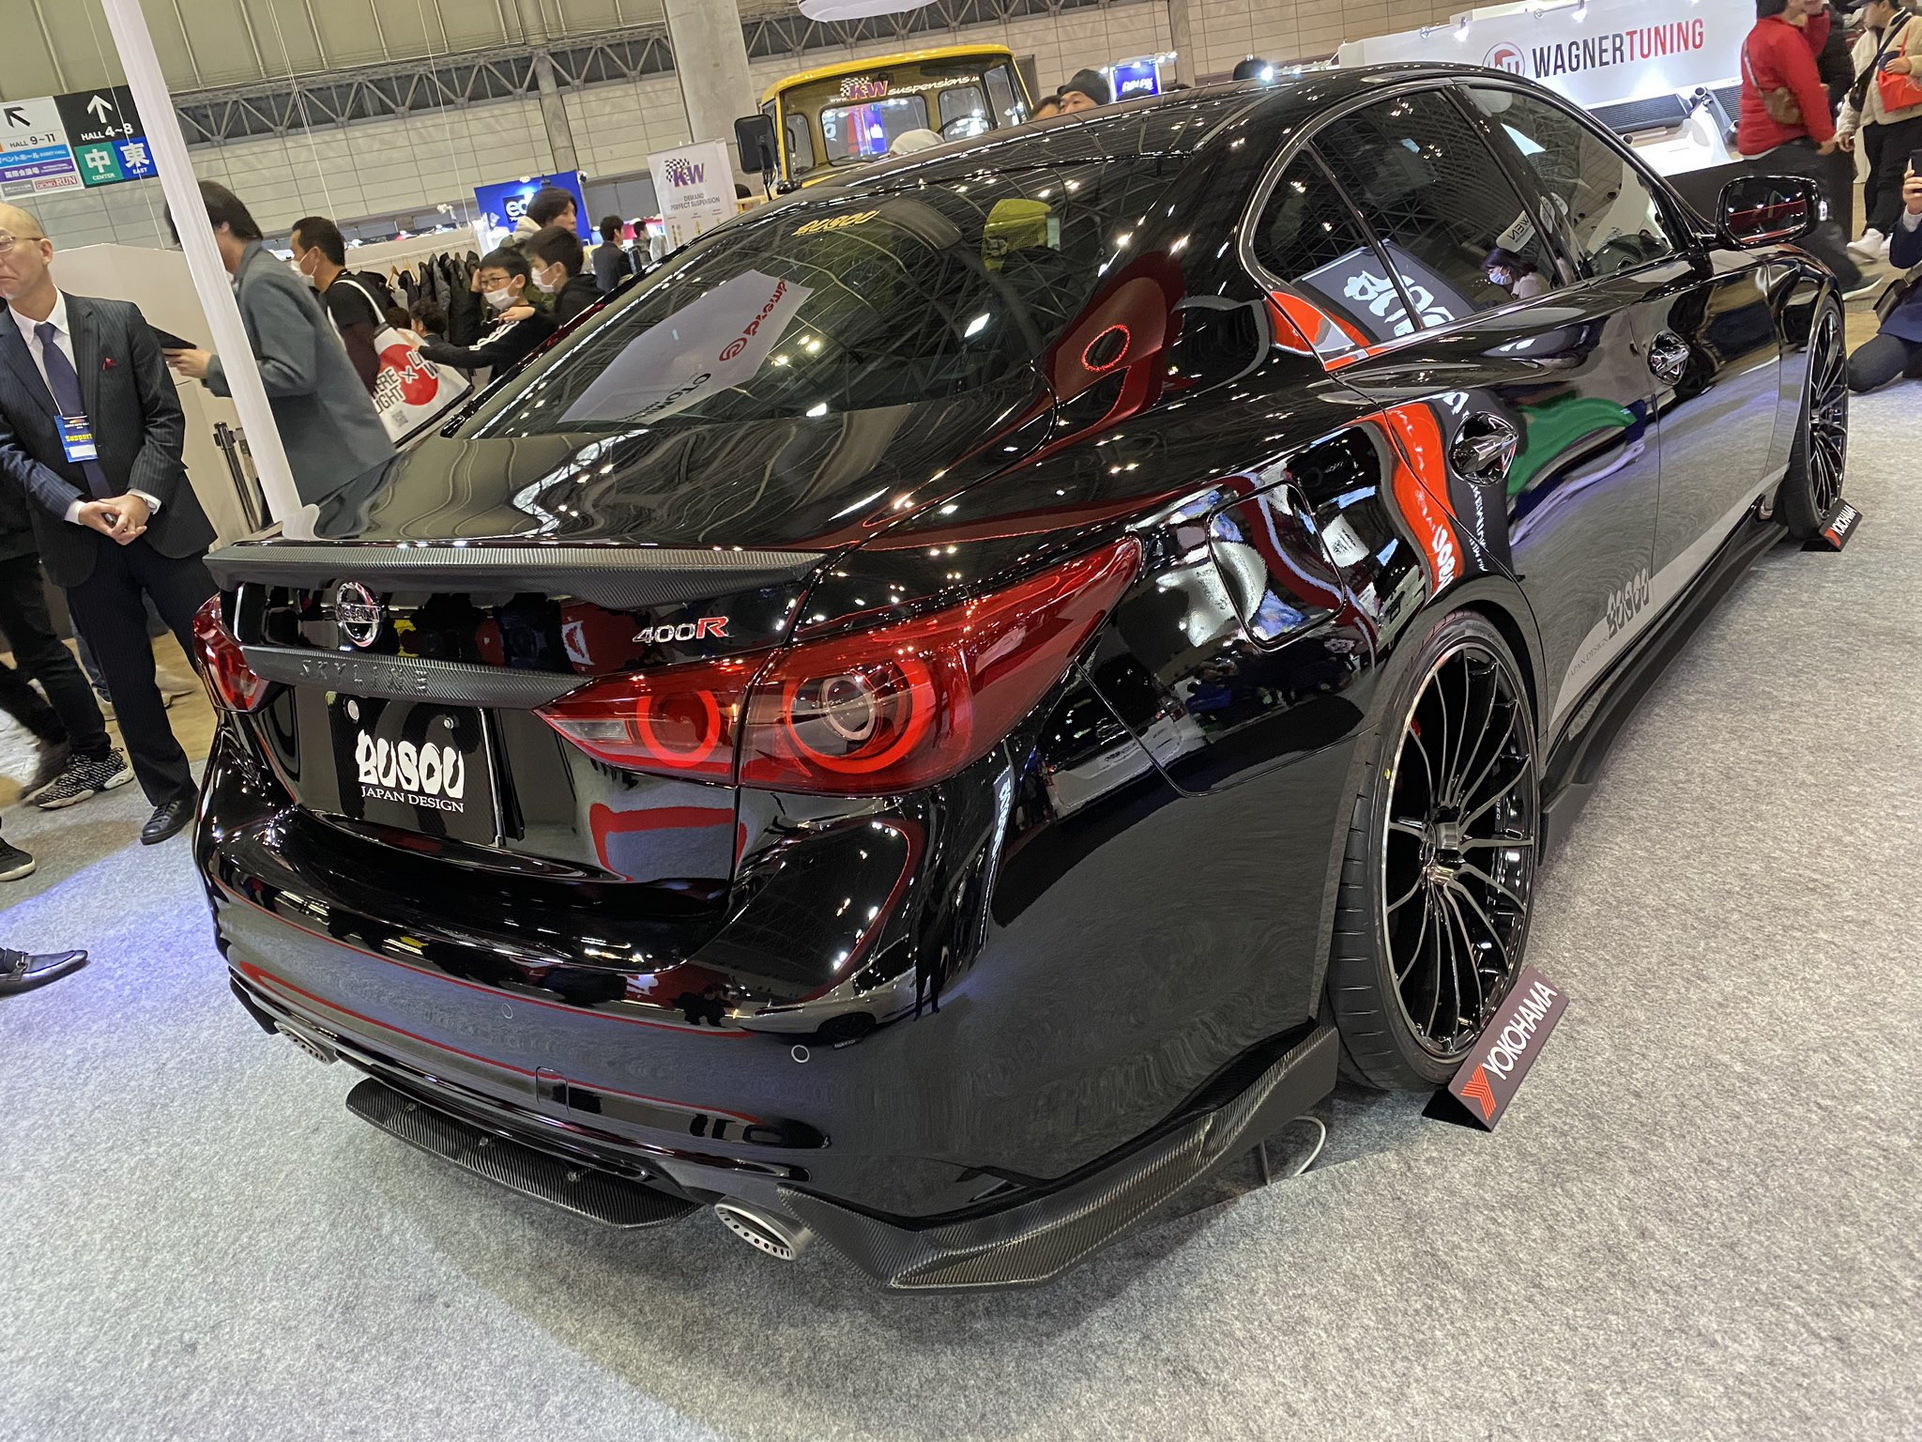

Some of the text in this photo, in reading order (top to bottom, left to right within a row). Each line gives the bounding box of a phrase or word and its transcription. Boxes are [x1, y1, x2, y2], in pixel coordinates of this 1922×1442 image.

[1532, 18, 1704, 79] WAGNERTUNING
[81, 131, 105, 141] HALL
[84, 148, 111, 173] 中
[120, 143, 150, 168] 東
[672, 163, 705, 188] KW
[1606, 566, 1651, 641] BUSOU
[632, 616, 729, 645] 400R
[299, 659, 428, 690] SKYLINE
[355, 728, 465, 799] BUSOU
[360, 785, 465, 813] JAPAN DESIGN
[1482, 980, 1558, 1081] YOKOHAMA
